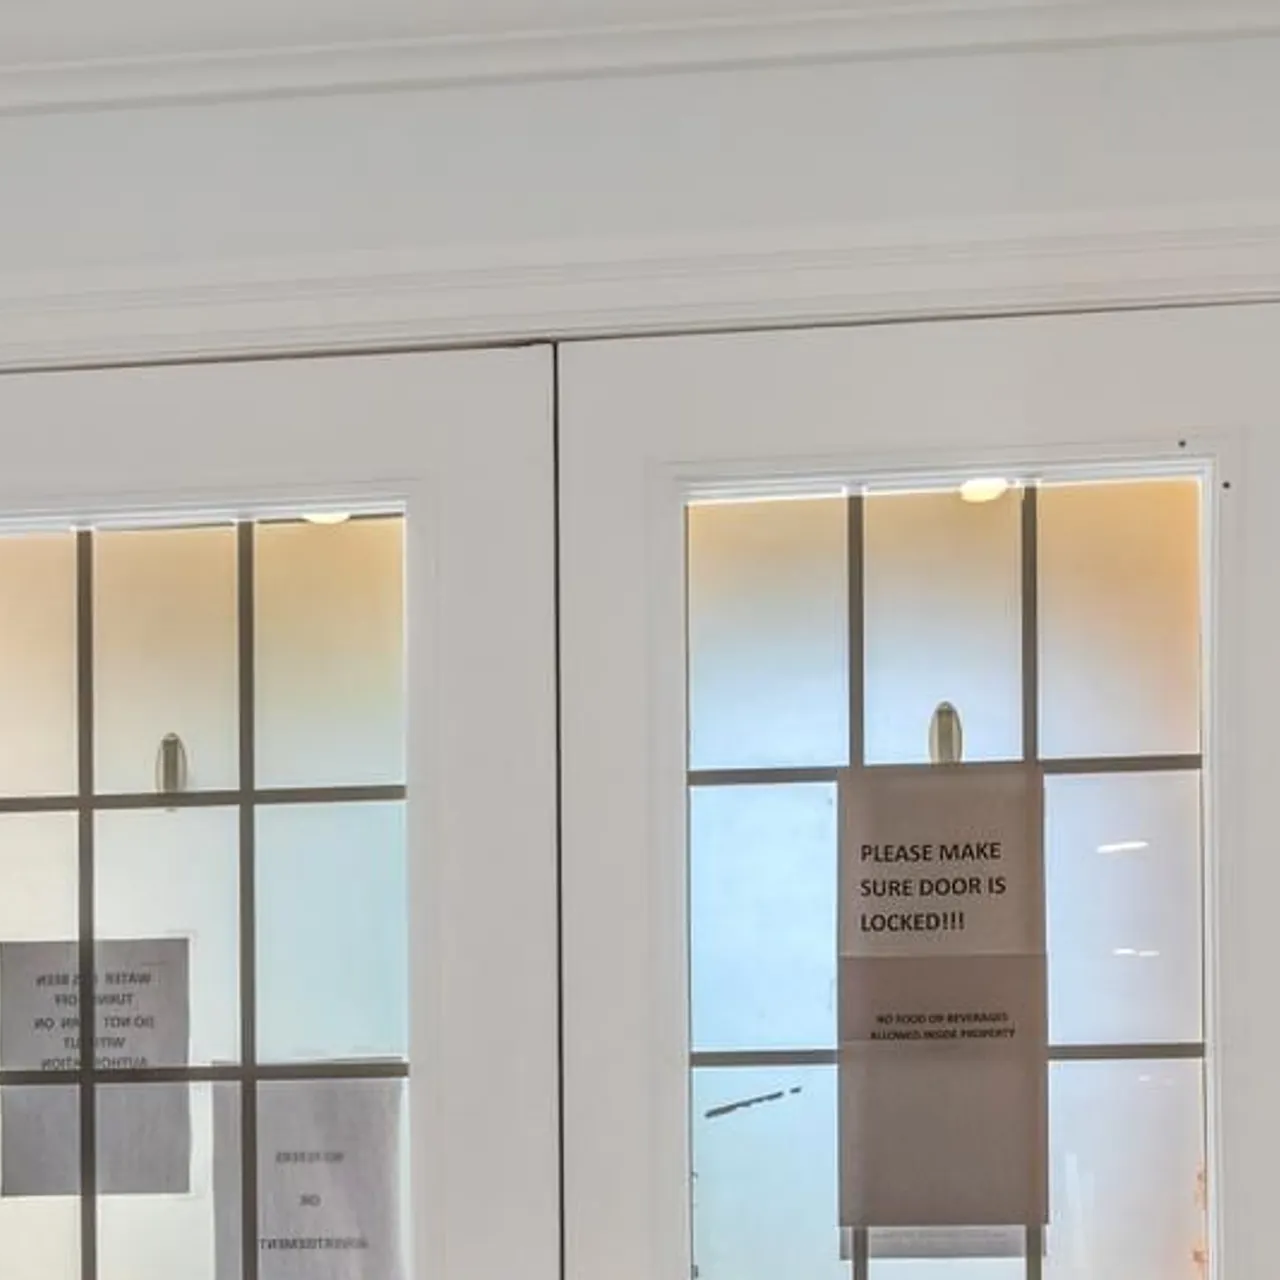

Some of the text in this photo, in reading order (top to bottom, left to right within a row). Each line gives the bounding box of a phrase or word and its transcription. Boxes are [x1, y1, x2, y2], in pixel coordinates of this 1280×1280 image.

[860, 842, 1001, 862] PLEASE MAKE
[860, 876, 1006, 897] SURE DOOR IS
[860, 912, 965, 932] LOCKED!!!
[896, 1014, 925, 1025] FOOD
